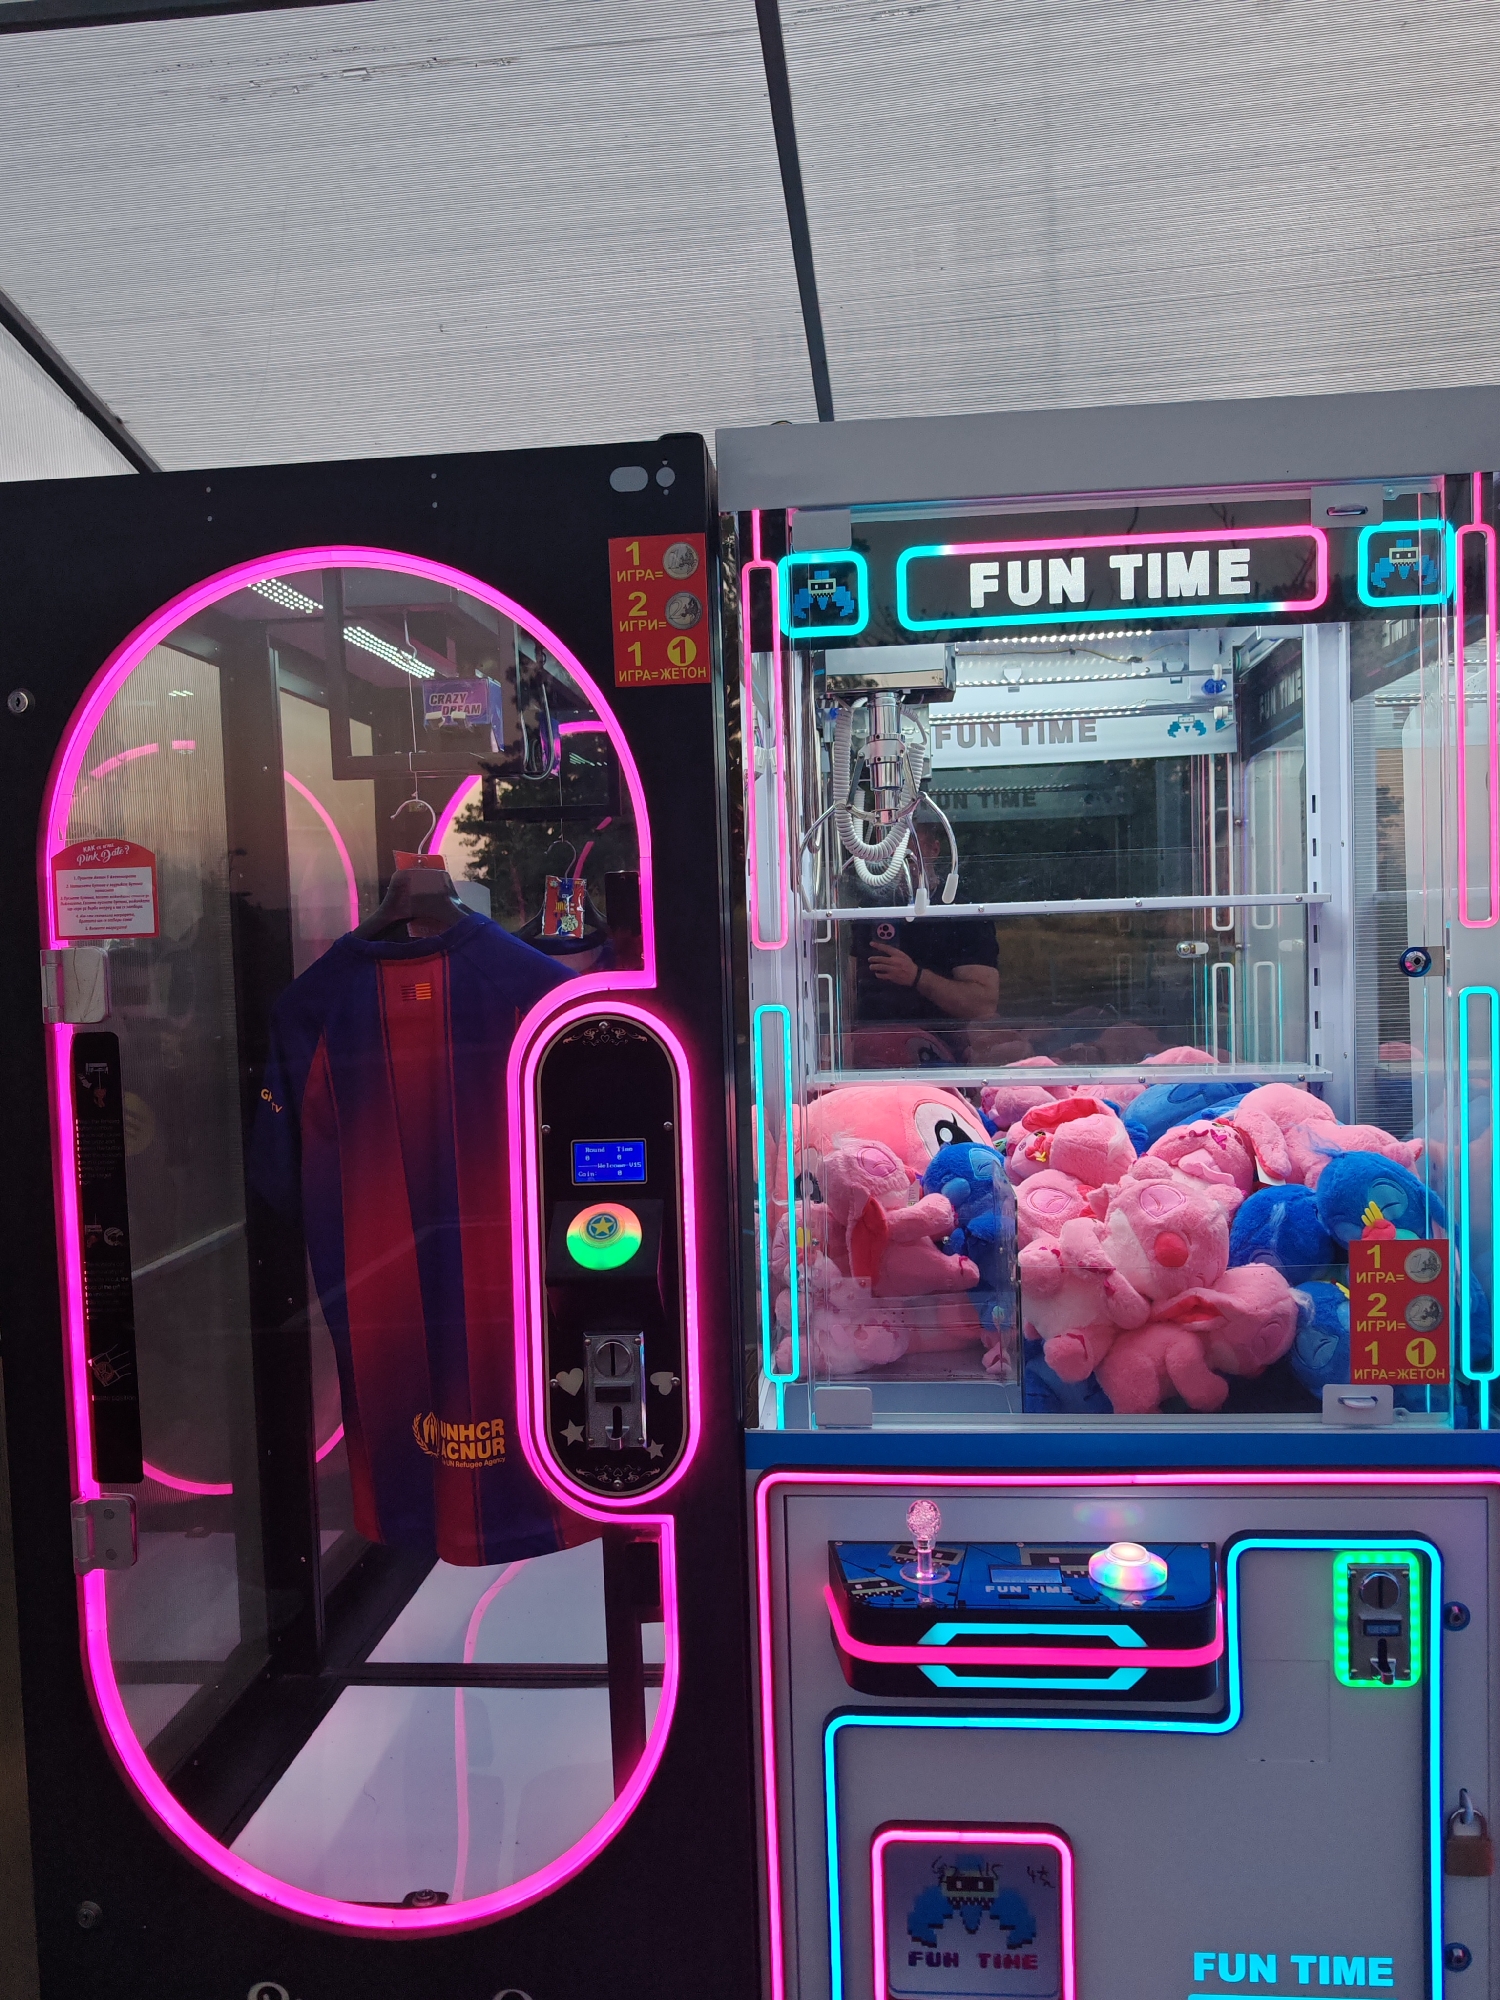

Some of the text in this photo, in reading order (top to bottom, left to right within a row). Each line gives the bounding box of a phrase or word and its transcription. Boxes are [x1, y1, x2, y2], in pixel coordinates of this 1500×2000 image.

[626, 542, 640, 566] 1
[617, 569, 664, 582] ИГРА=
[970, 549, 1250, 608] FUN TIME
[628, 592, 648, 617] 2
[619, 620, 667, 632] ИГРИ=
[628, 639, 687, 666] 1 1
[430, 692, 467, 706] CRAZY
[935, 718, 1098, 749] FUN TIME
[76, 851, 101, 866] Pink
[1367, 1245, 1381, 1269] 1
[1356, 1272, 1405, 1284] ИГРА=
[1367, 1293, 1387, 1317] 2
[1357, 1320, 1406, 1332] ИГРИ=
[1365, 1340, 1425, 1366] 1 1
[441, 1419, 505, 1441] UNHCR
[441, 1437, 505, 1459] ACNUR
[456, 1461, 483, 1469] Refugee
[484, 1456, 506, 1467] Agency
[985, 1585, 1073, 1594] FUN TIME
[1193, 1952, 1394, 1987] FUN TIME
